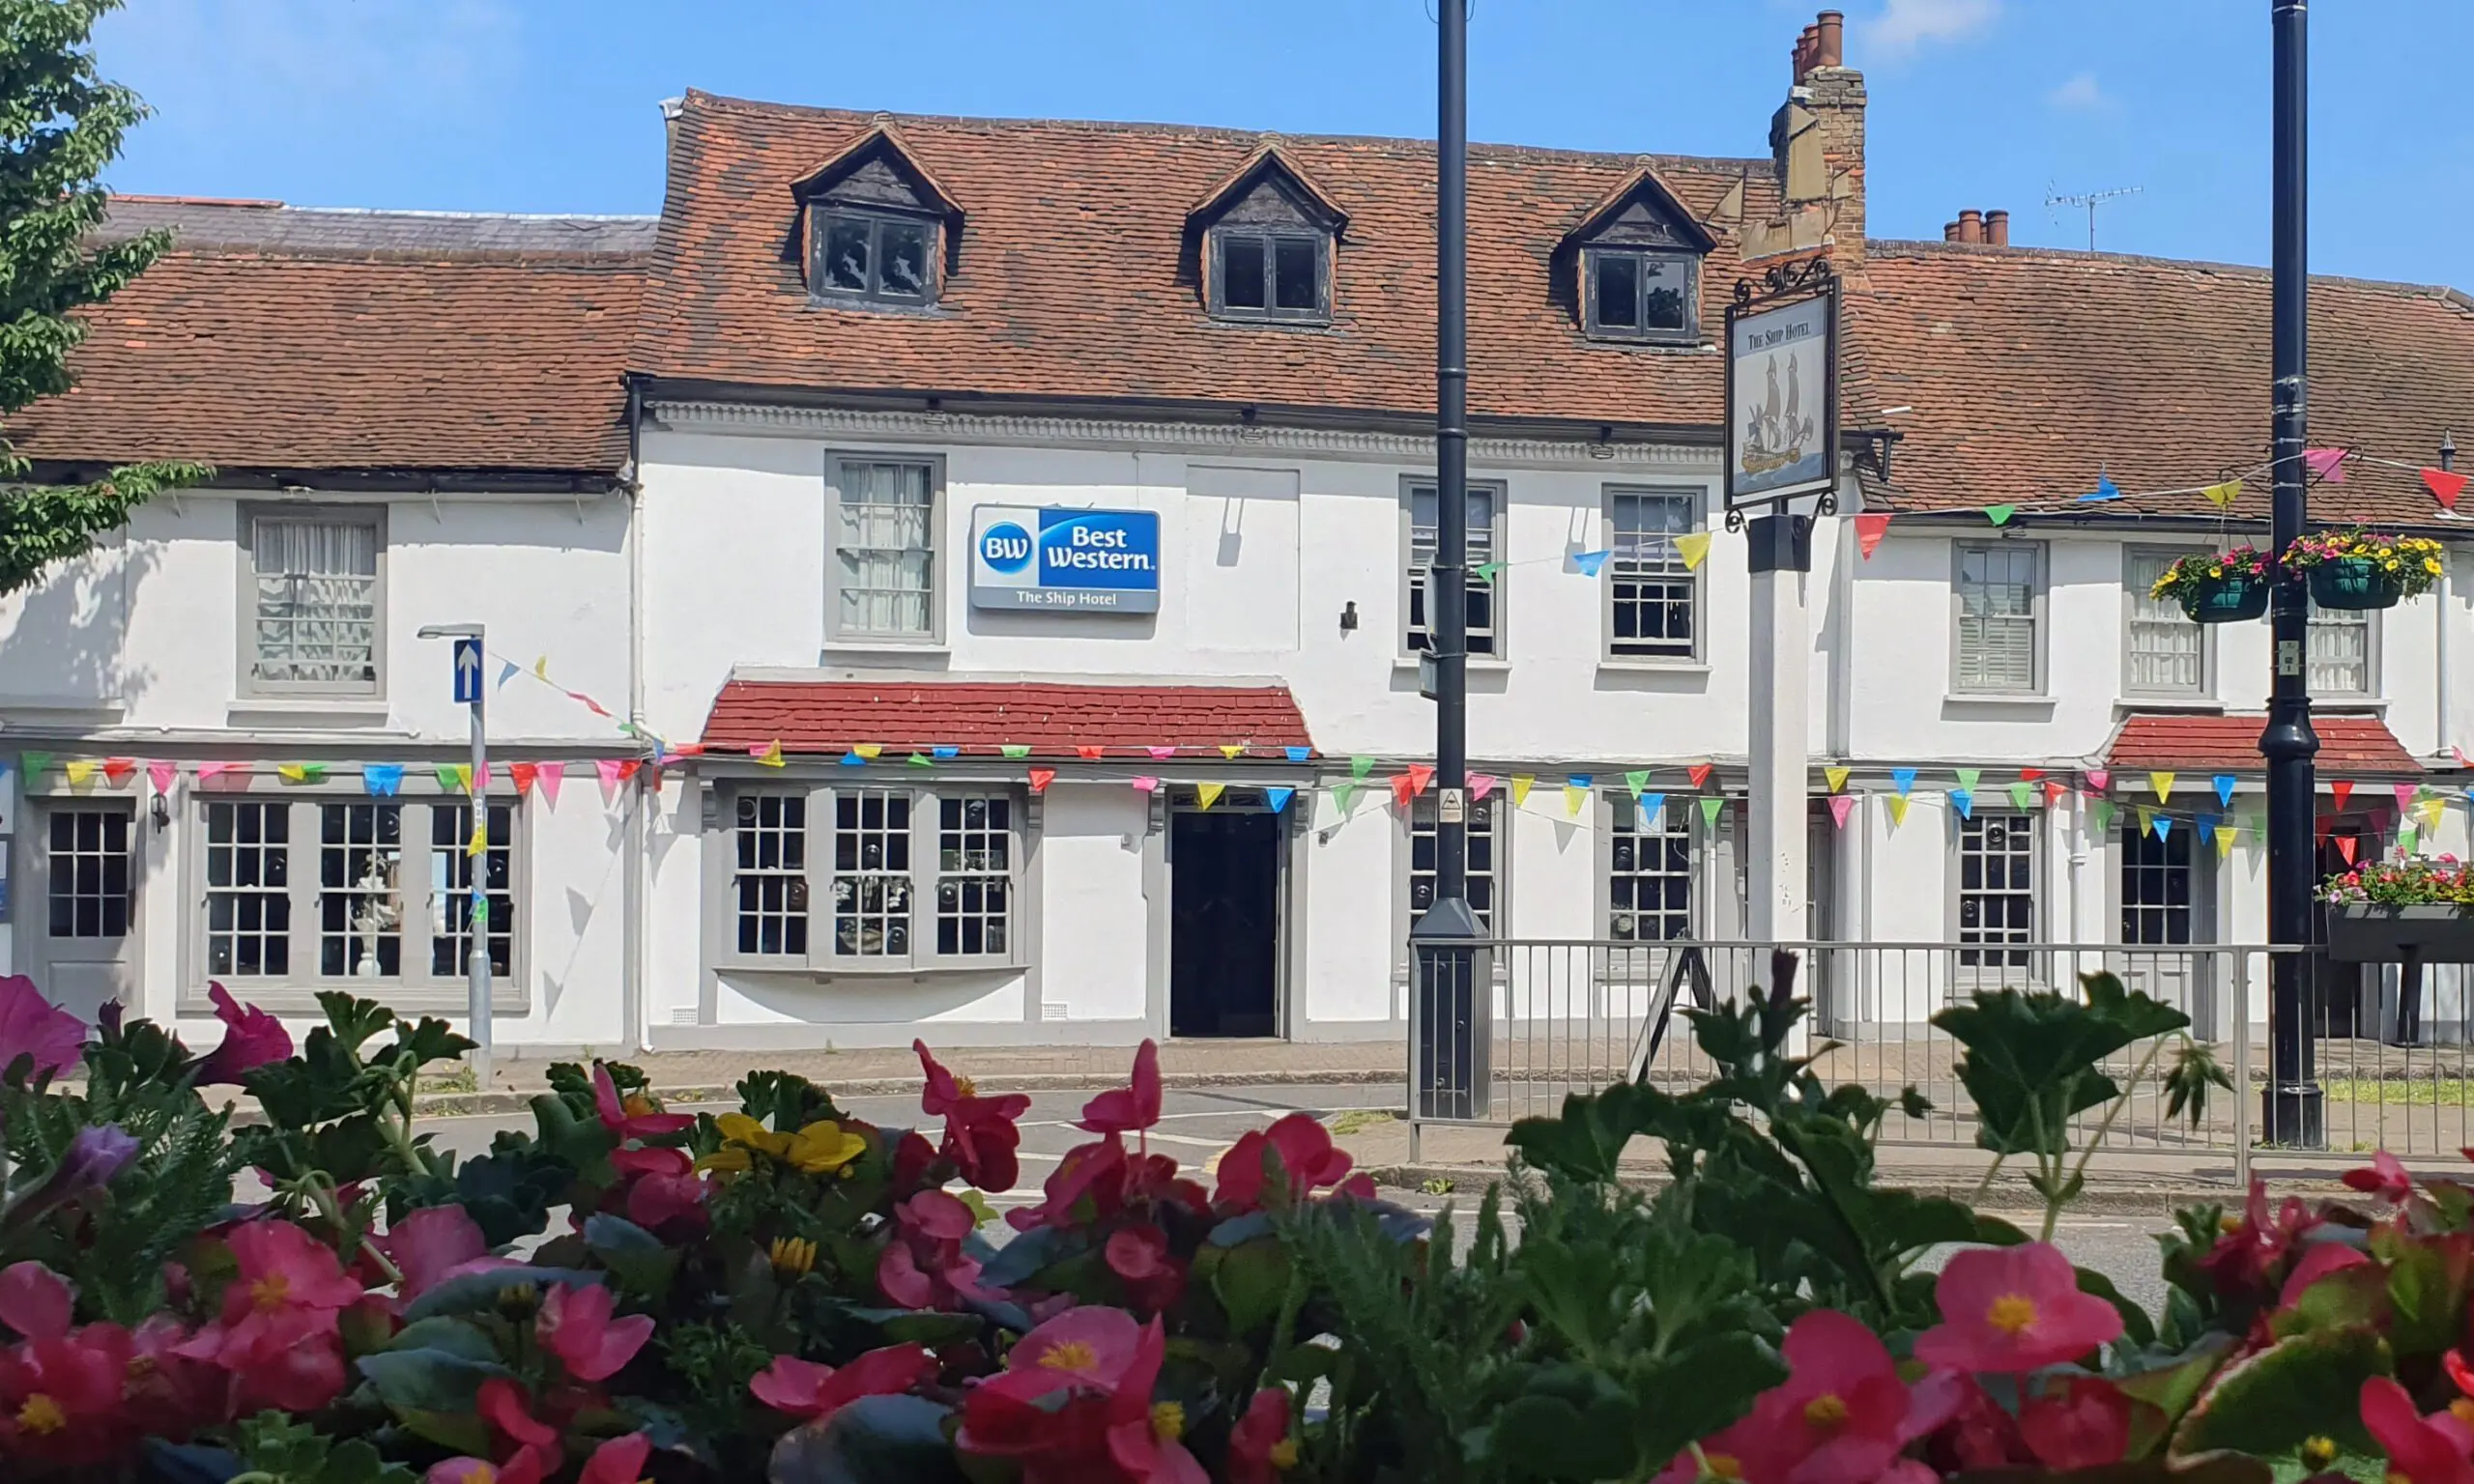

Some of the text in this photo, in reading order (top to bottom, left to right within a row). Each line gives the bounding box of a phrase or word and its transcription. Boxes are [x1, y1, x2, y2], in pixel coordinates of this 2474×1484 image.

[987, 537, 1028, 559] BW
[1073, 526, 1127, 548] Best
[1048, 547, 1150, 570] Western
[1017, 590, 1117, 608] The Ship Hotel
